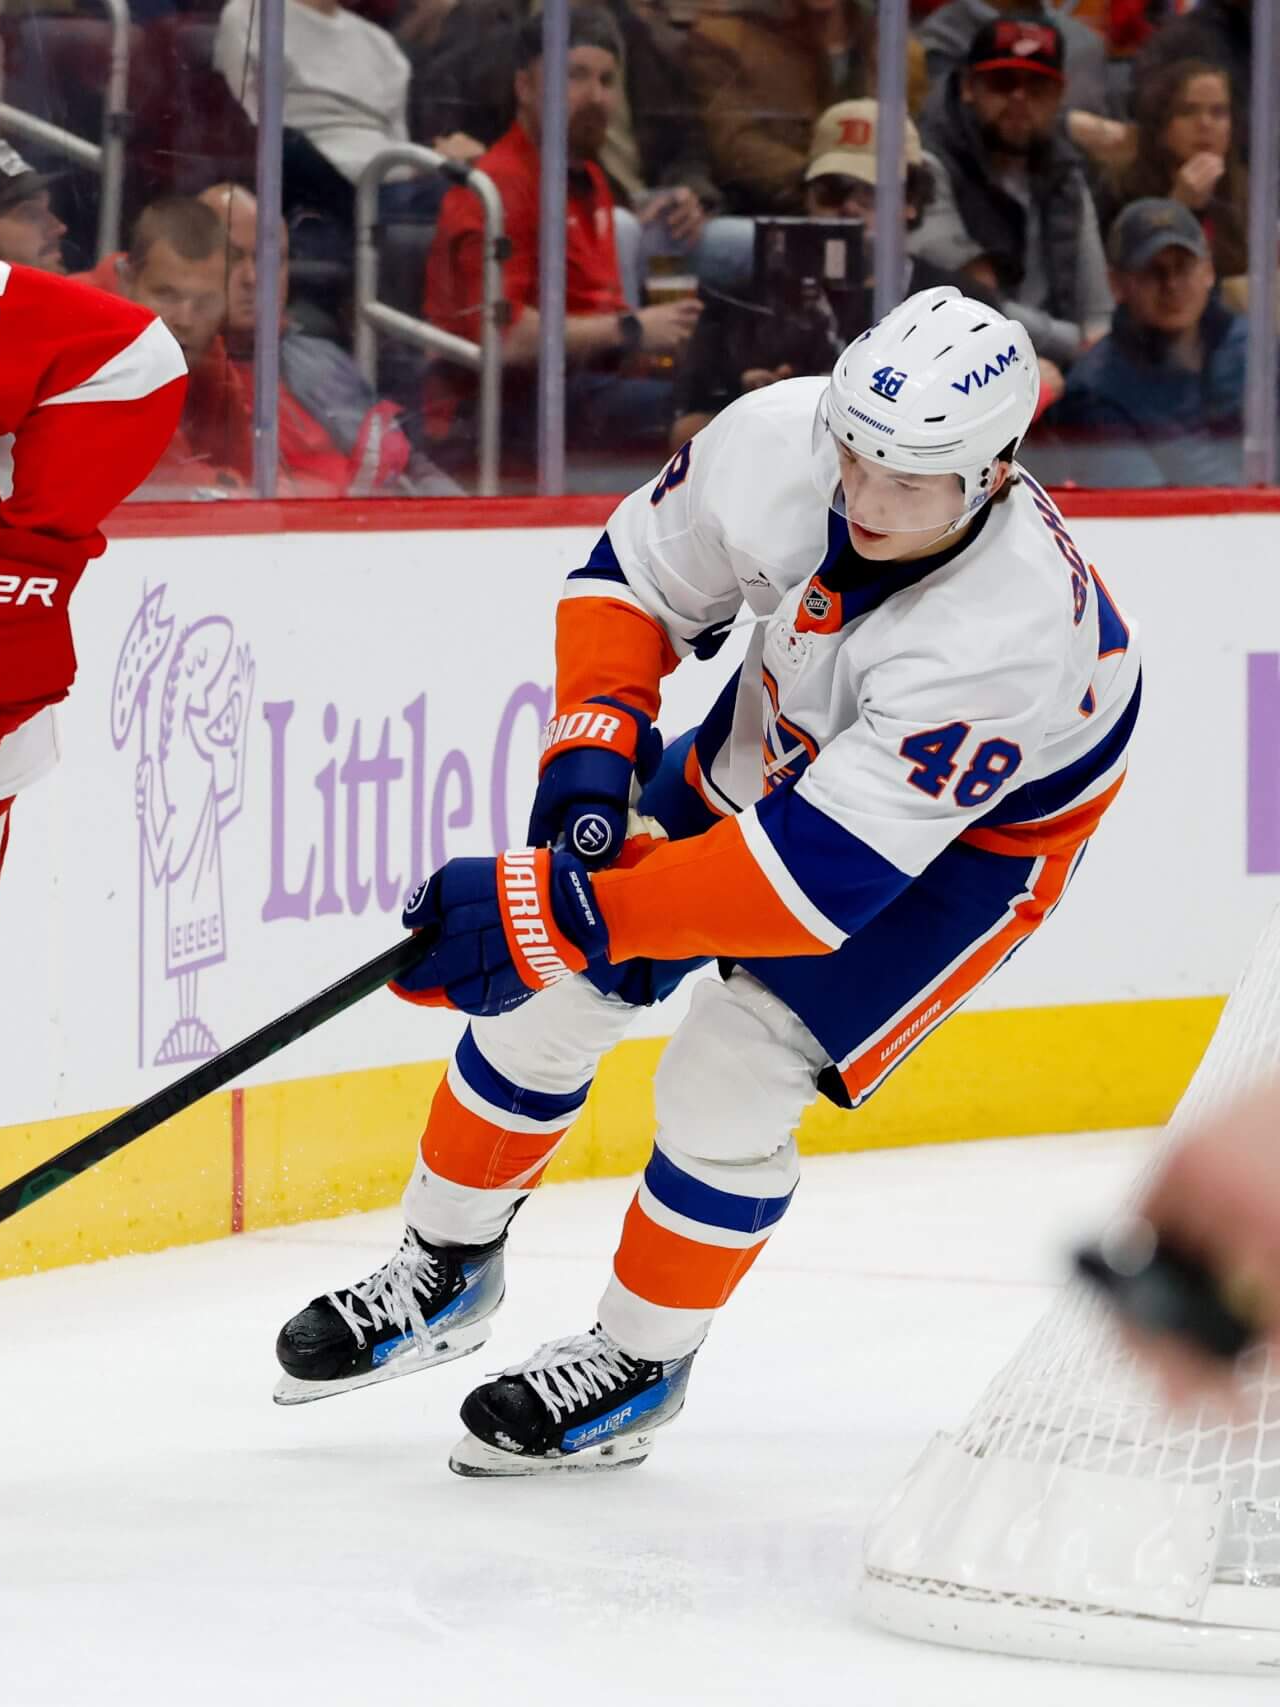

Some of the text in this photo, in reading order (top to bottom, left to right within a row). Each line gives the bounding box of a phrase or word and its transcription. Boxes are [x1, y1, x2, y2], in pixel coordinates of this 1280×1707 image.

[872, 366, 909, 398] 48
[951, 344, 1018, 396] VIAM
[898, 720, 1023, 808] 48
[261, 691, 474, 922] Little
[880, 1001, 943, 1062] WARRIOR
